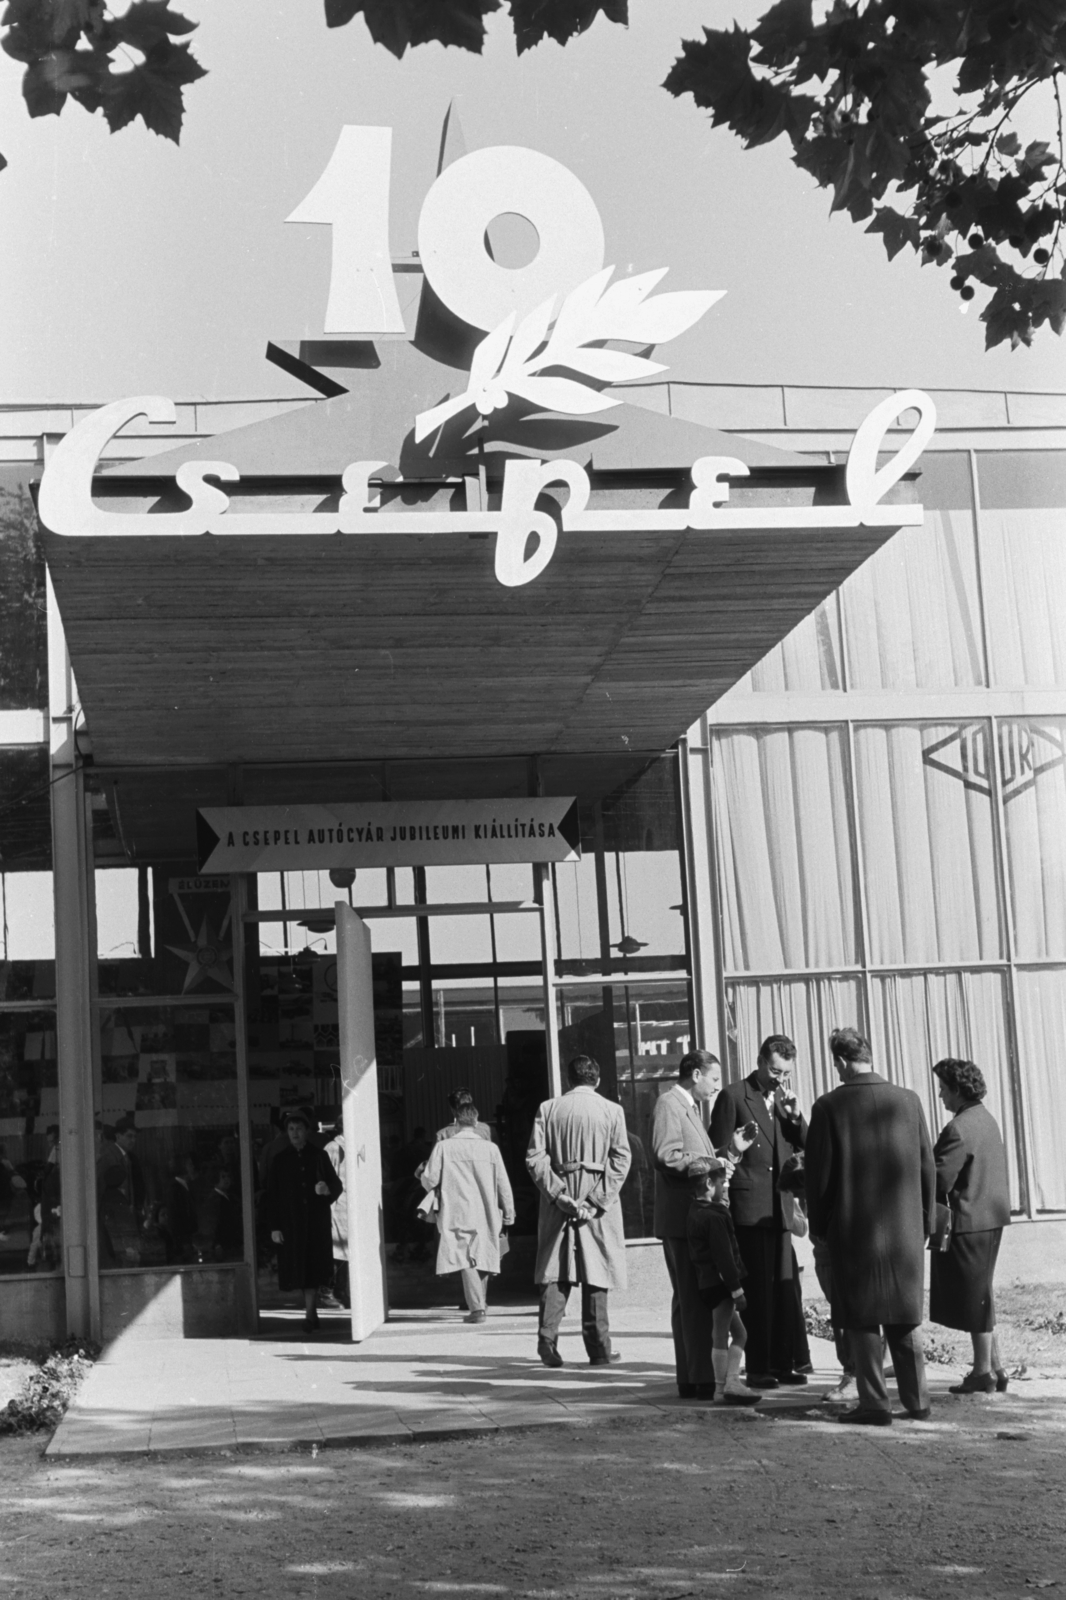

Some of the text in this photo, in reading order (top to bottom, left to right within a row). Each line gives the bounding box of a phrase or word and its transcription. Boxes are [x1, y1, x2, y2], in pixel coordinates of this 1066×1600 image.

[283, 124, 606, 338] 10
[38, 389, 924, 587] Csepel
[227, 831, 235, 847] A
[242, 829, 300, 847] CSEPEL
[390, 824, 466, 842] JUBILEUMI
[474, 817, 556, 840] KIÁLLÍTÁSA
